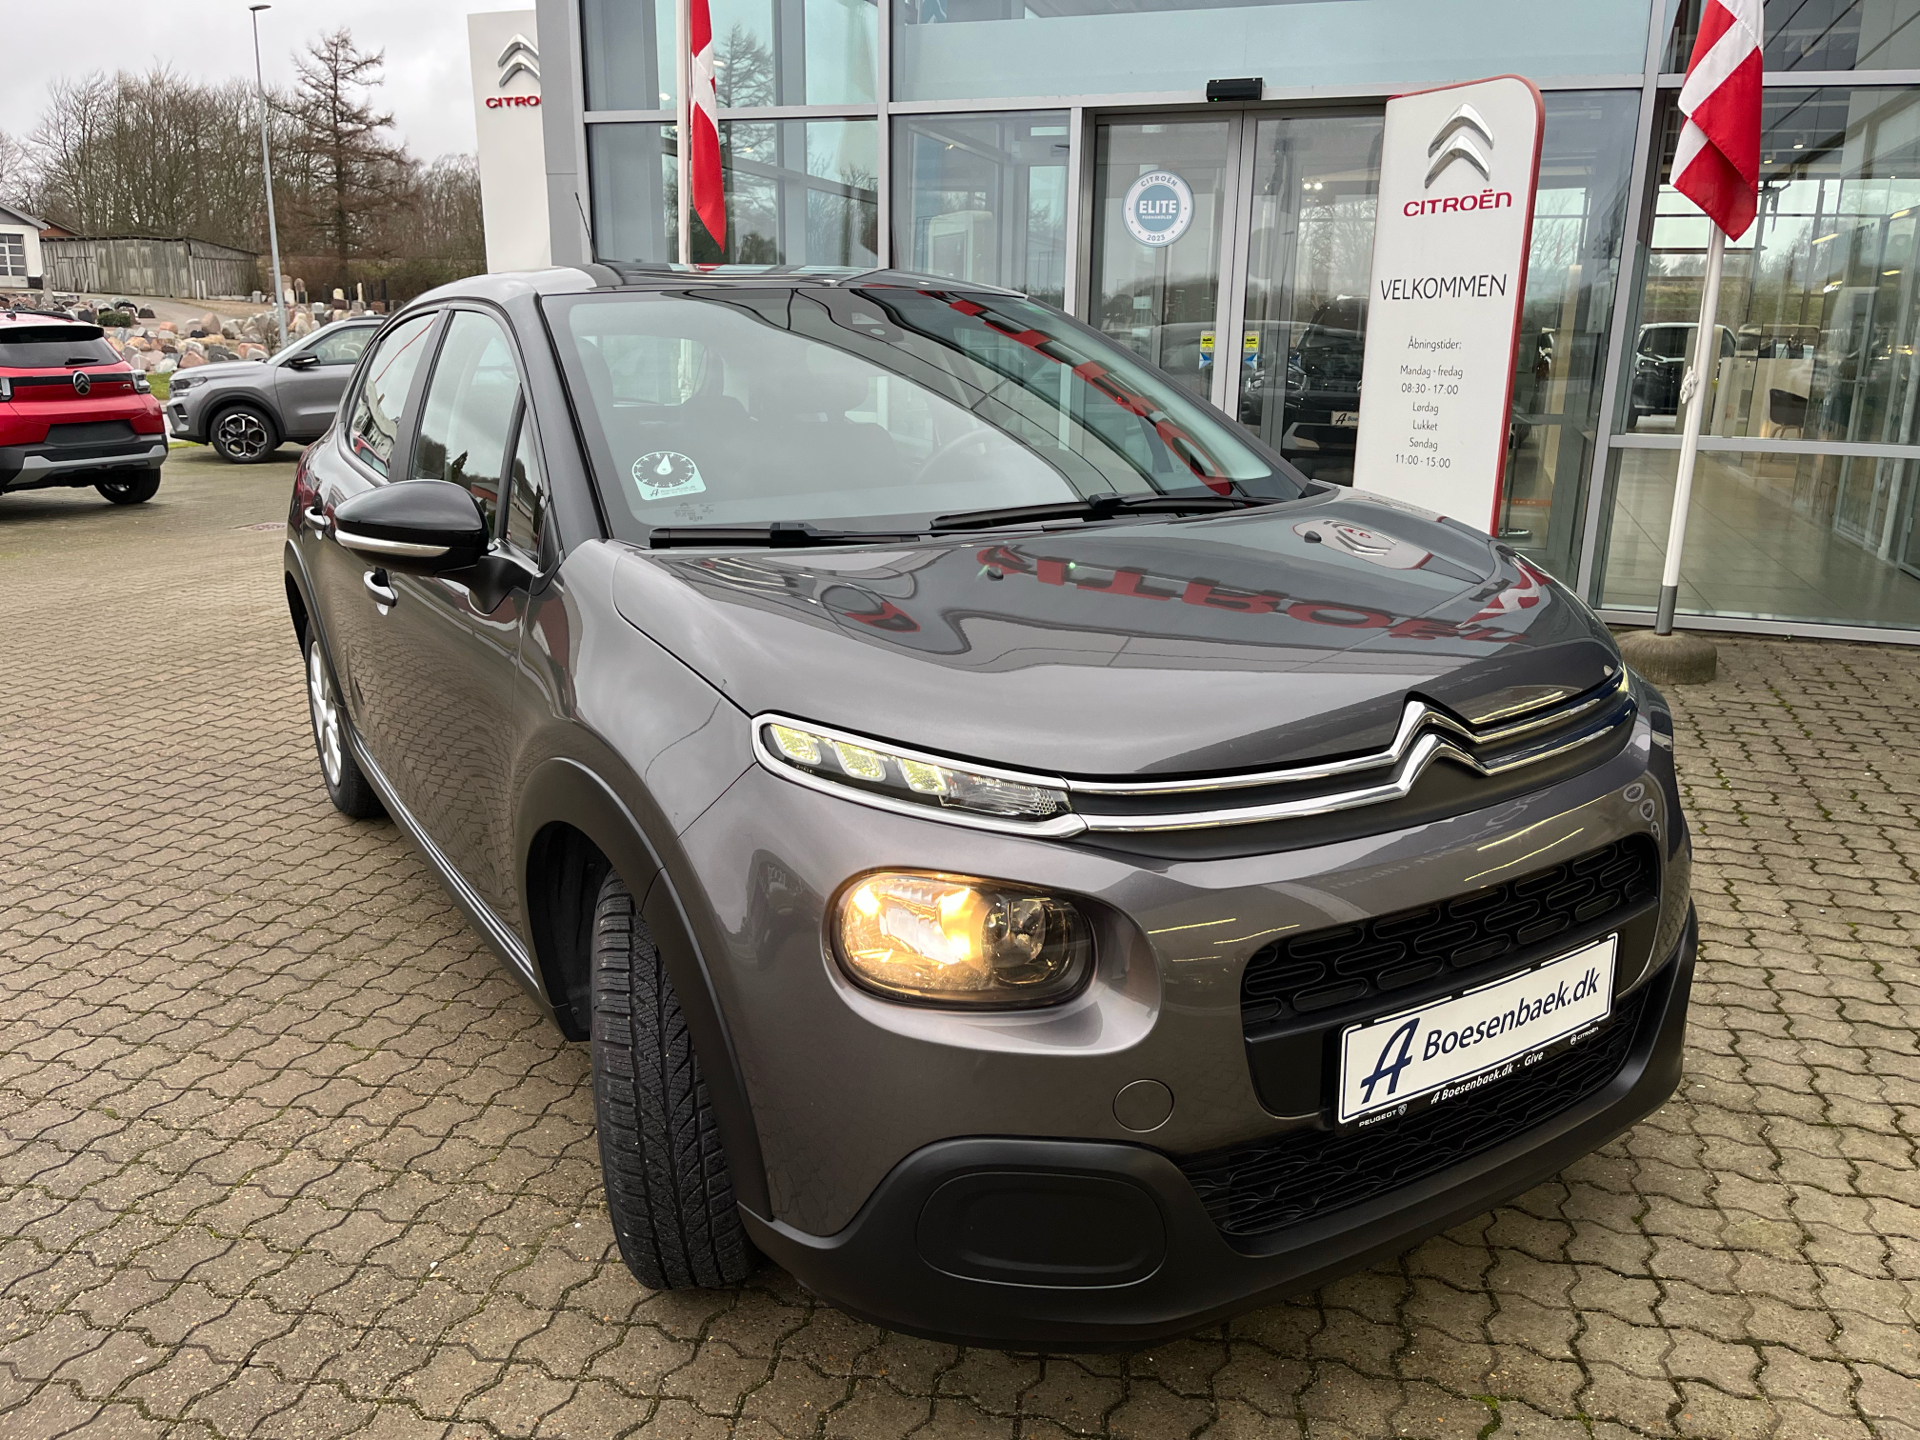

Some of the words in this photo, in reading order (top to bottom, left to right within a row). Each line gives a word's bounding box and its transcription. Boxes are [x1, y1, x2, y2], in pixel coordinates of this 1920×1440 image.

[485, 95, 542, 109] CITRO
[1139, 200, 1177, 214] ELITE
[1381, 273, 1507, 300] VELKOMMEN
[1407, 335, 1462, 352] Åbningstider:
[1400, 364, 1431, 379] Mandag
[1438, 364, 1463, 380] fredag
[1401, 382, 1426, 394] 08:30
[1433, 383, 1459, 395] 17:00
[1412, 401, 1439, 416] Lørdag
[1412, 419, 1438, 431] Lukket
[1409, 436, 1438, 452] Søndag
[1395, 453, 1419, 465] 11:00
[1426, 456, 1451, 469] 15:00
[1422, 966, 1601, 1062] Boesenbaek.dk
[1441, 1063, 1513, 1101] Boesenbaek.dk
[1524, 1051, 1544, 1066] Give
[1358, 1109, 1397, 1127] PEUGEOT
